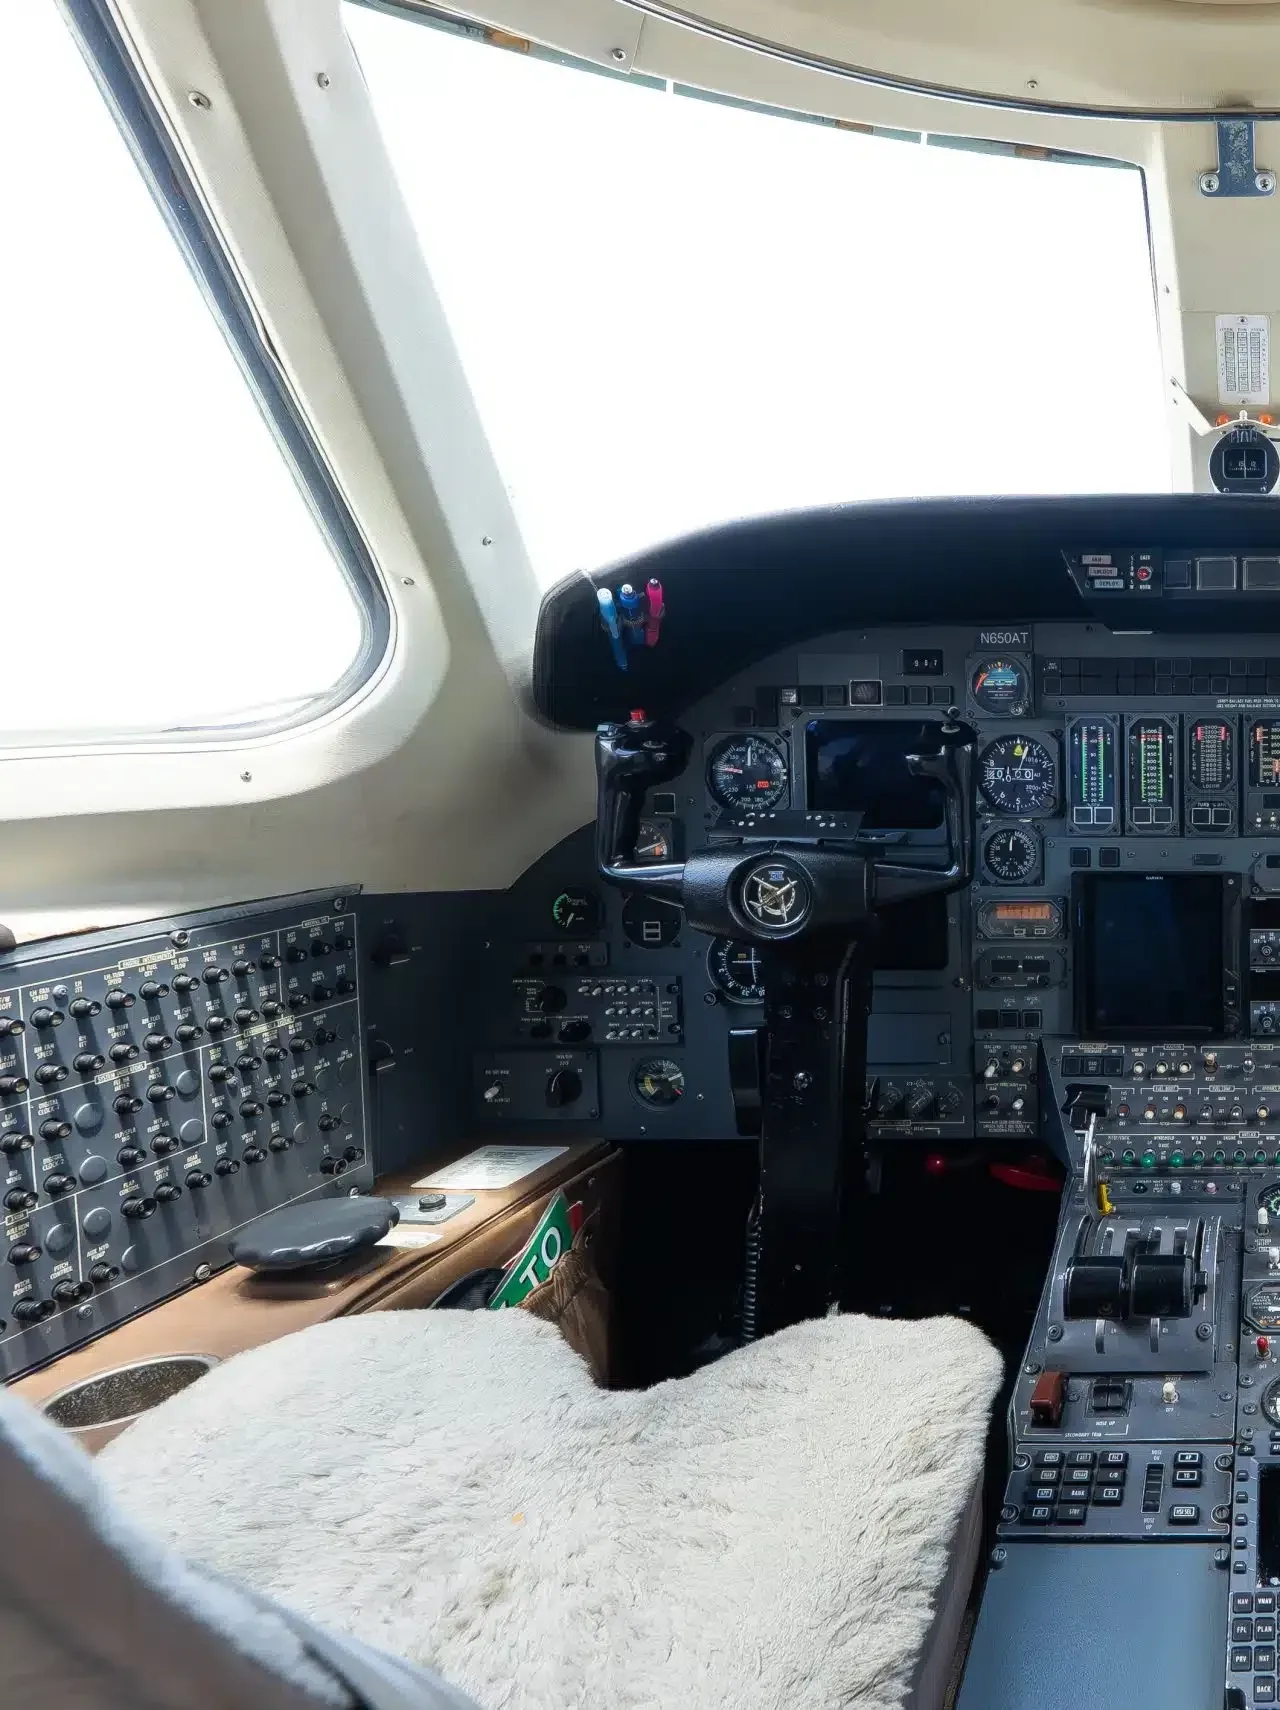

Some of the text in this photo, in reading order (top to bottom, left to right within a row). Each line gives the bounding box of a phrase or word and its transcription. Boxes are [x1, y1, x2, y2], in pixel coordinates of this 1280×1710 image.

[980, 632, 1029, 644] N650AT
[519, 1226, 562, 1290] TO
[1235, 1655, 1247, 1663] PRV
[1256, 1685, 1272, 1693] BACK
